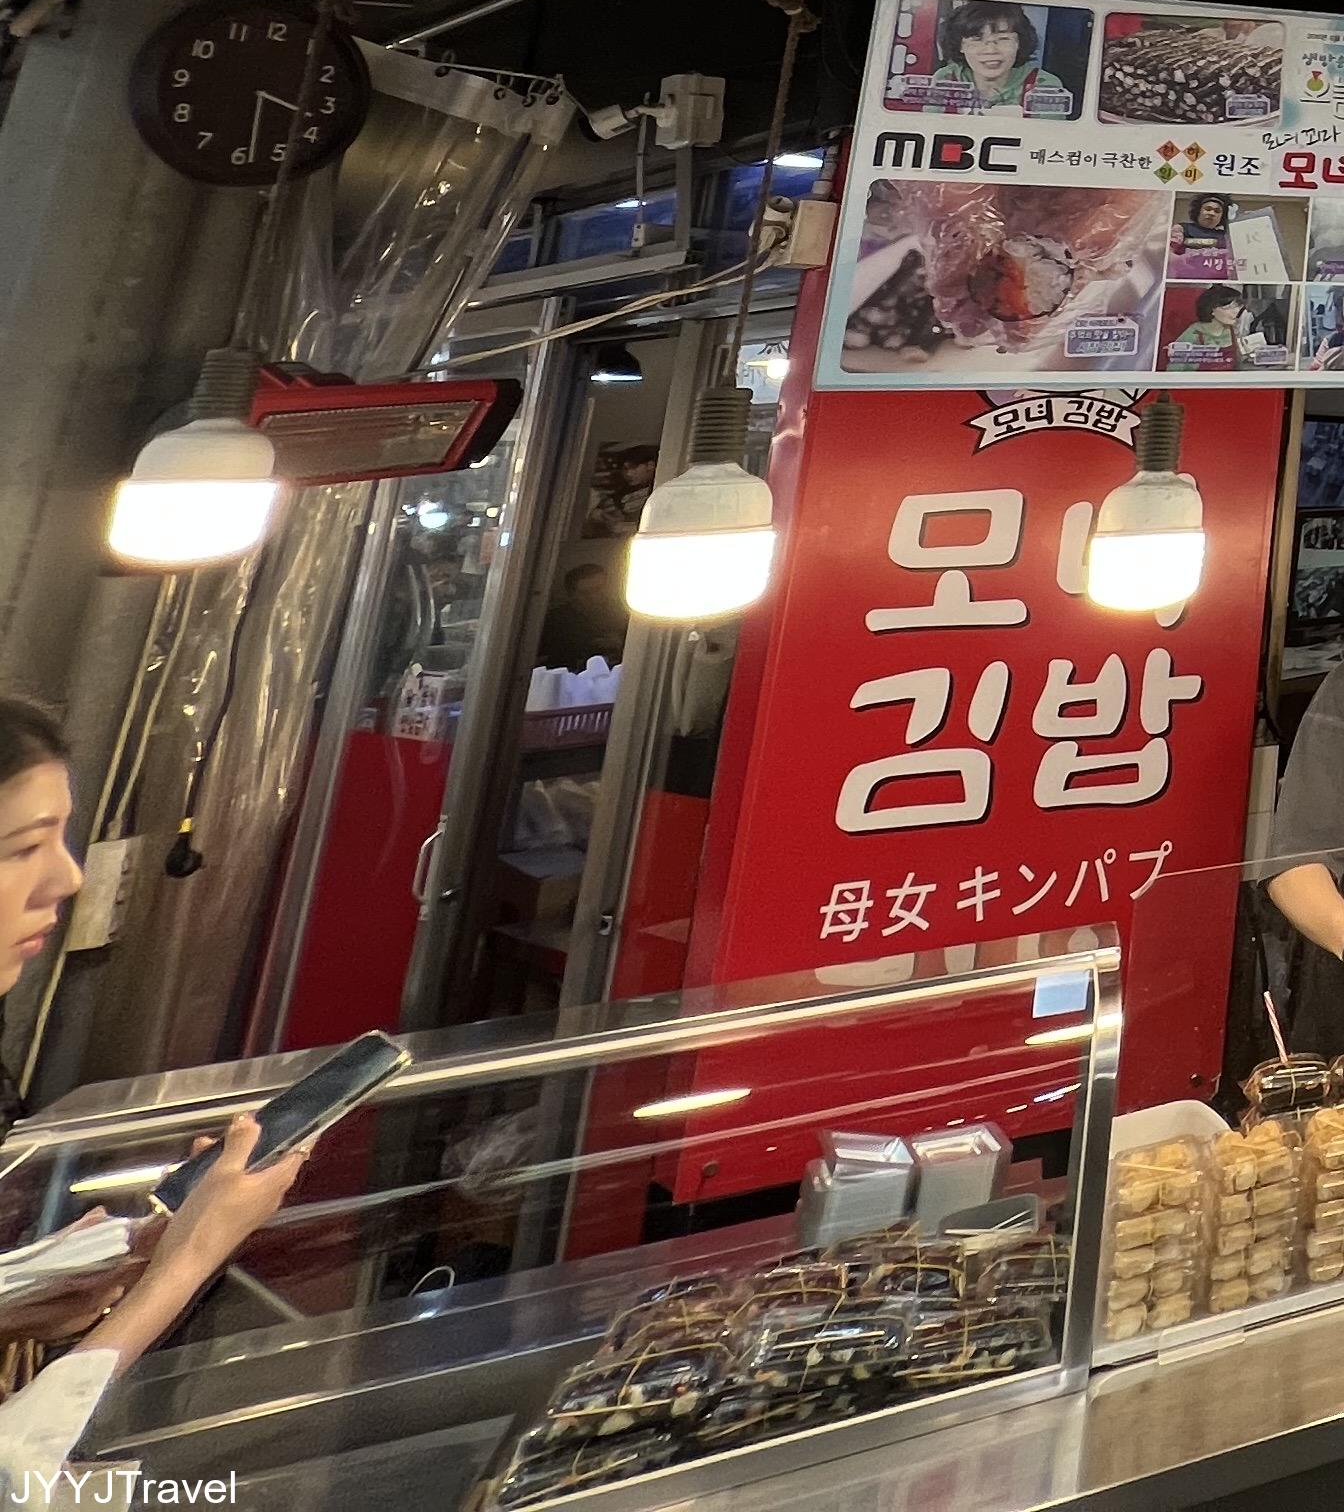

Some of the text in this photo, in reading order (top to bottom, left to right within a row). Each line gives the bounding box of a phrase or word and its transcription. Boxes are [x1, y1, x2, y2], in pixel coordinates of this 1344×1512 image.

[228, 23, 248, 42] 11
[267, 22, 287, 42] 12
[192, 39, 216, 59] 10
[172, 69, 190, 88] 9
[319, 65, 336, 83] 2
[173, 103, 191, 123] 8
[320, 96, 336, 115] 3
[197, 131, 214, 150] 7
[303, 126, 320, 144] 4
[230, 147, 248, 166] 6
[270, 143, 288, 162] 5
[872, 131, 1022, 173] MBC
[1213, 154, 1263, 178] 원조
[993, 399, 1127, 438] 모녀 김밥
[834, 647, 1202, 833] 김밥
[818, 871, 938, 943] 母女
